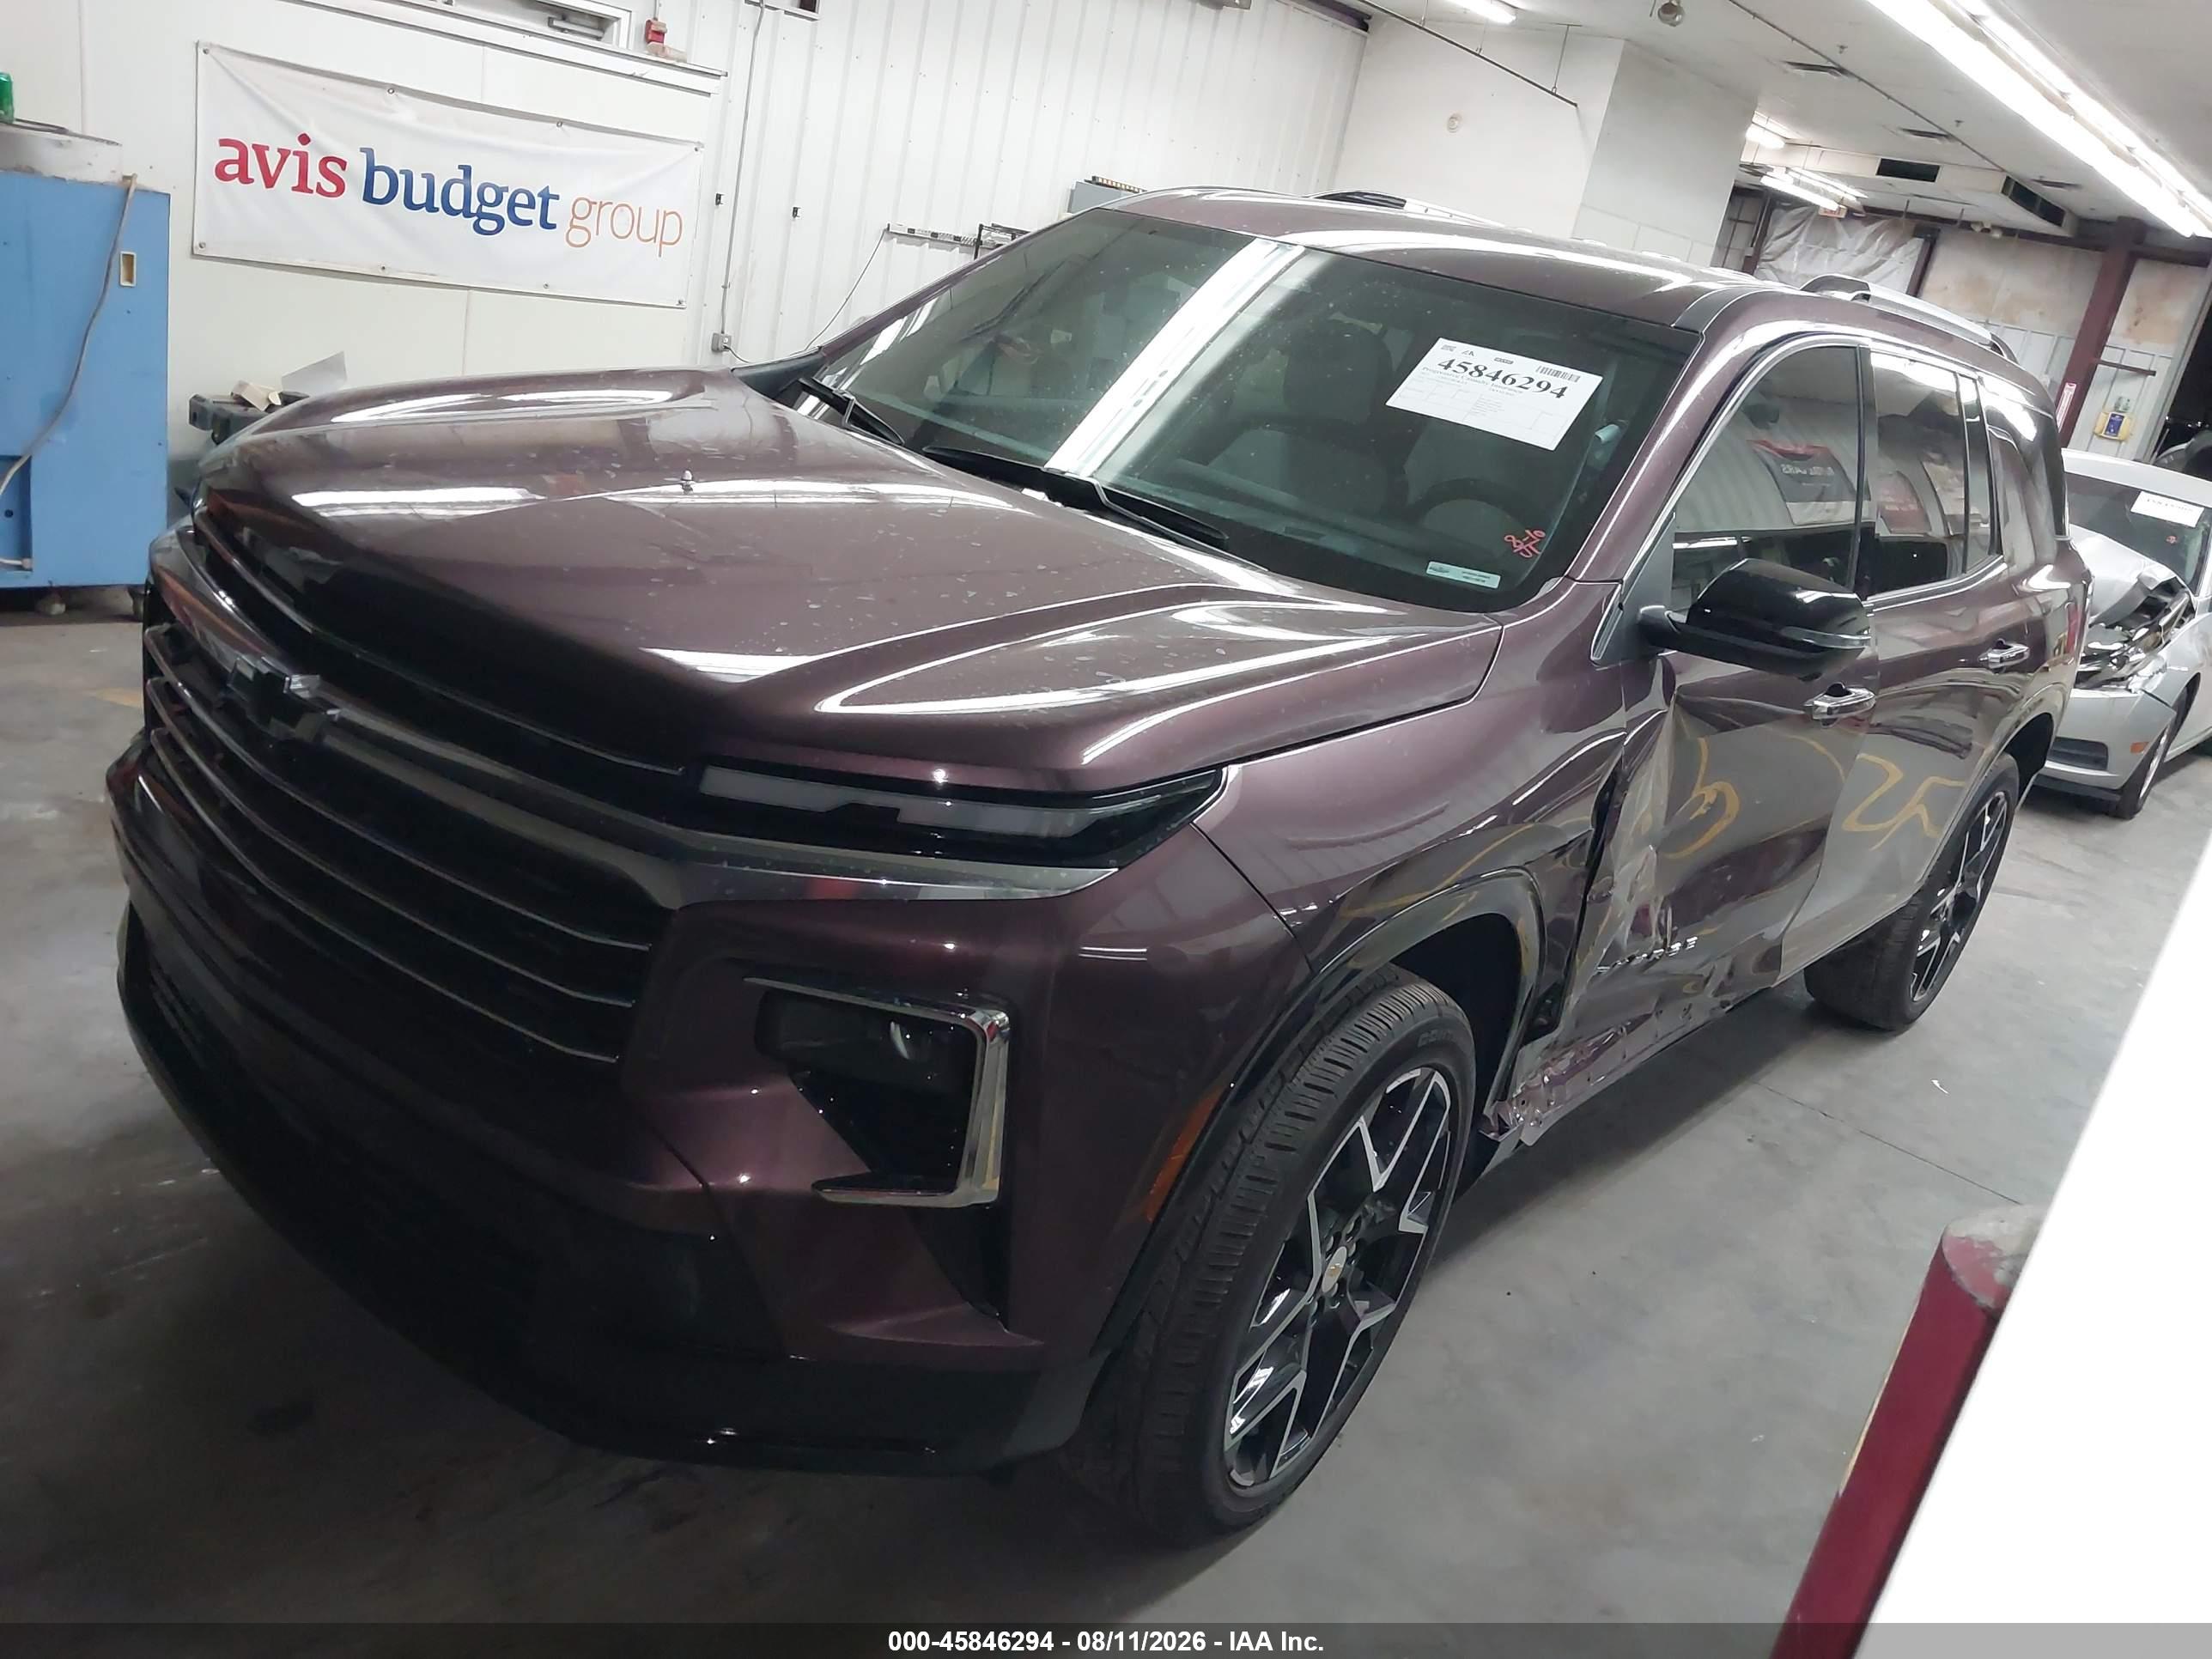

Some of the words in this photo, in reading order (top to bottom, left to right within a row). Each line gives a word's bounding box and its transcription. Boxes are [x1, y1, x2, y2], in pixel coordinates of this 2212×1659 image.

[214, 132, 349, 198] avis
[359, 147, 561, 236] budget
[565, 196, 684, 258] group
[1437, 358, 1569, 399] 45846294
